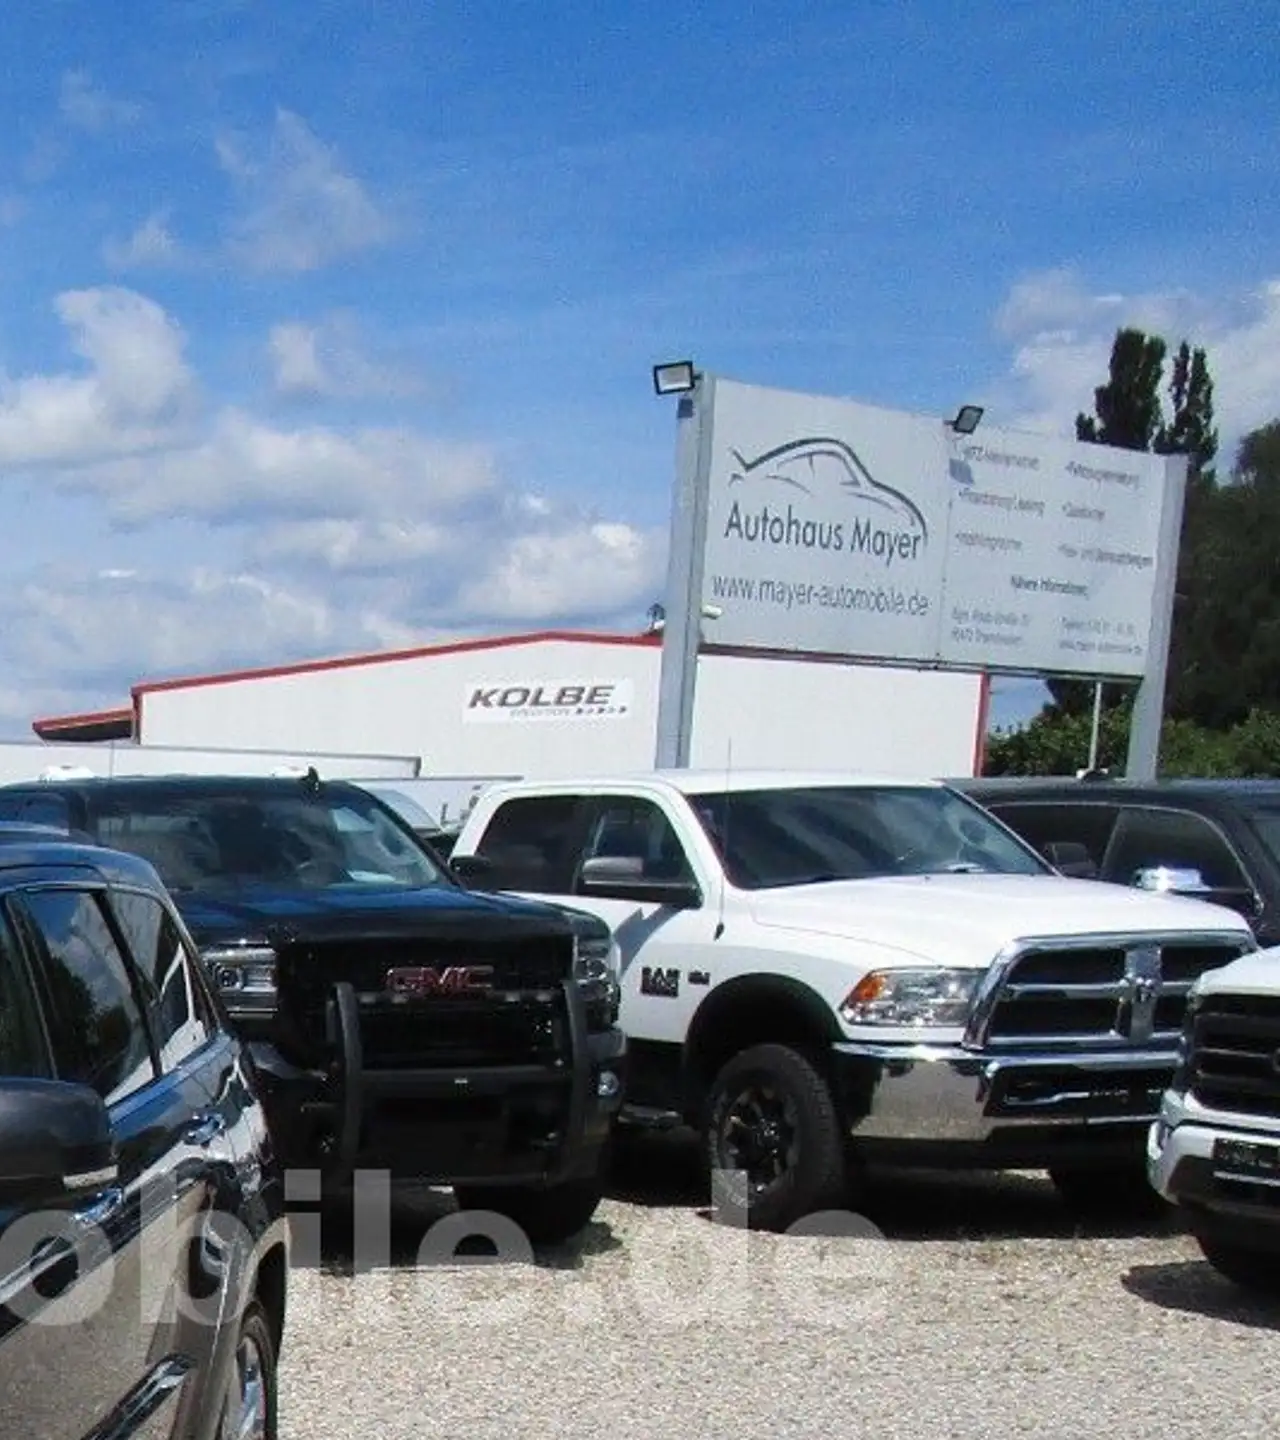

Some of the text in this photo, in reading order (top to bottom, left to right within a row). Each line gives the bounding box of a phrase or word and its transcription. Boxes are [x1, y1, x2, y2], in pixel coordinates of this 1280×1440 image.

[724, 501, 922, 567] Autohaus Mayer
[711, 575, 930, 616] www.mayer-automobile.de
[468, 685, 616, 709] KOLBE
[385, 964, 495, 993] GMC
